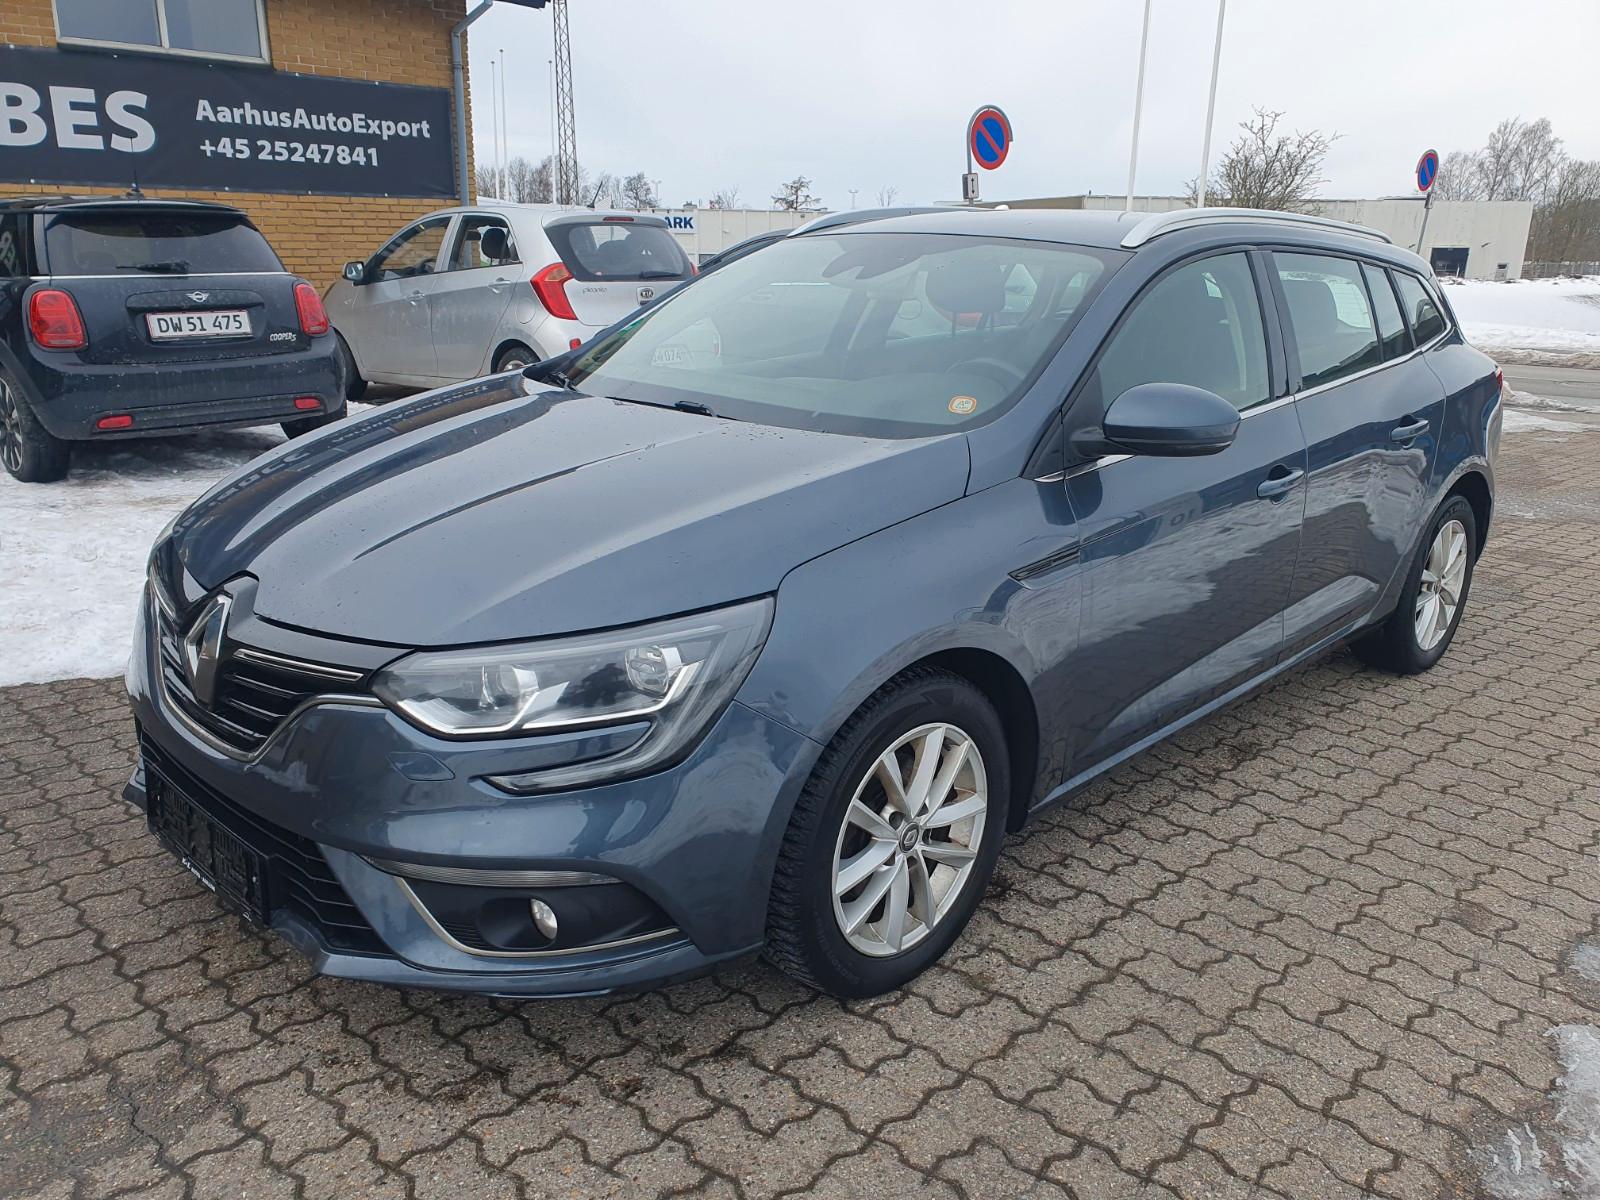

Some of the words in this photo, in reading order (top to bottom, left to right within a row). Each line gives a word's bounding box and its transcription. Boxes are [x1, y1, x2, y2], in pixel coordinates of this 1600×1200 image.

[0, 82, 155, 152] BES
[196, 99, 431, 139] AarhusAutoExport
[200, 137, 250, 160] +45
[258, 140, 379, 166] 25247841
[157, 317, 183, 333] DW
[187, 316, 206, 332] 51
[213, 314, 243, 331] 475
